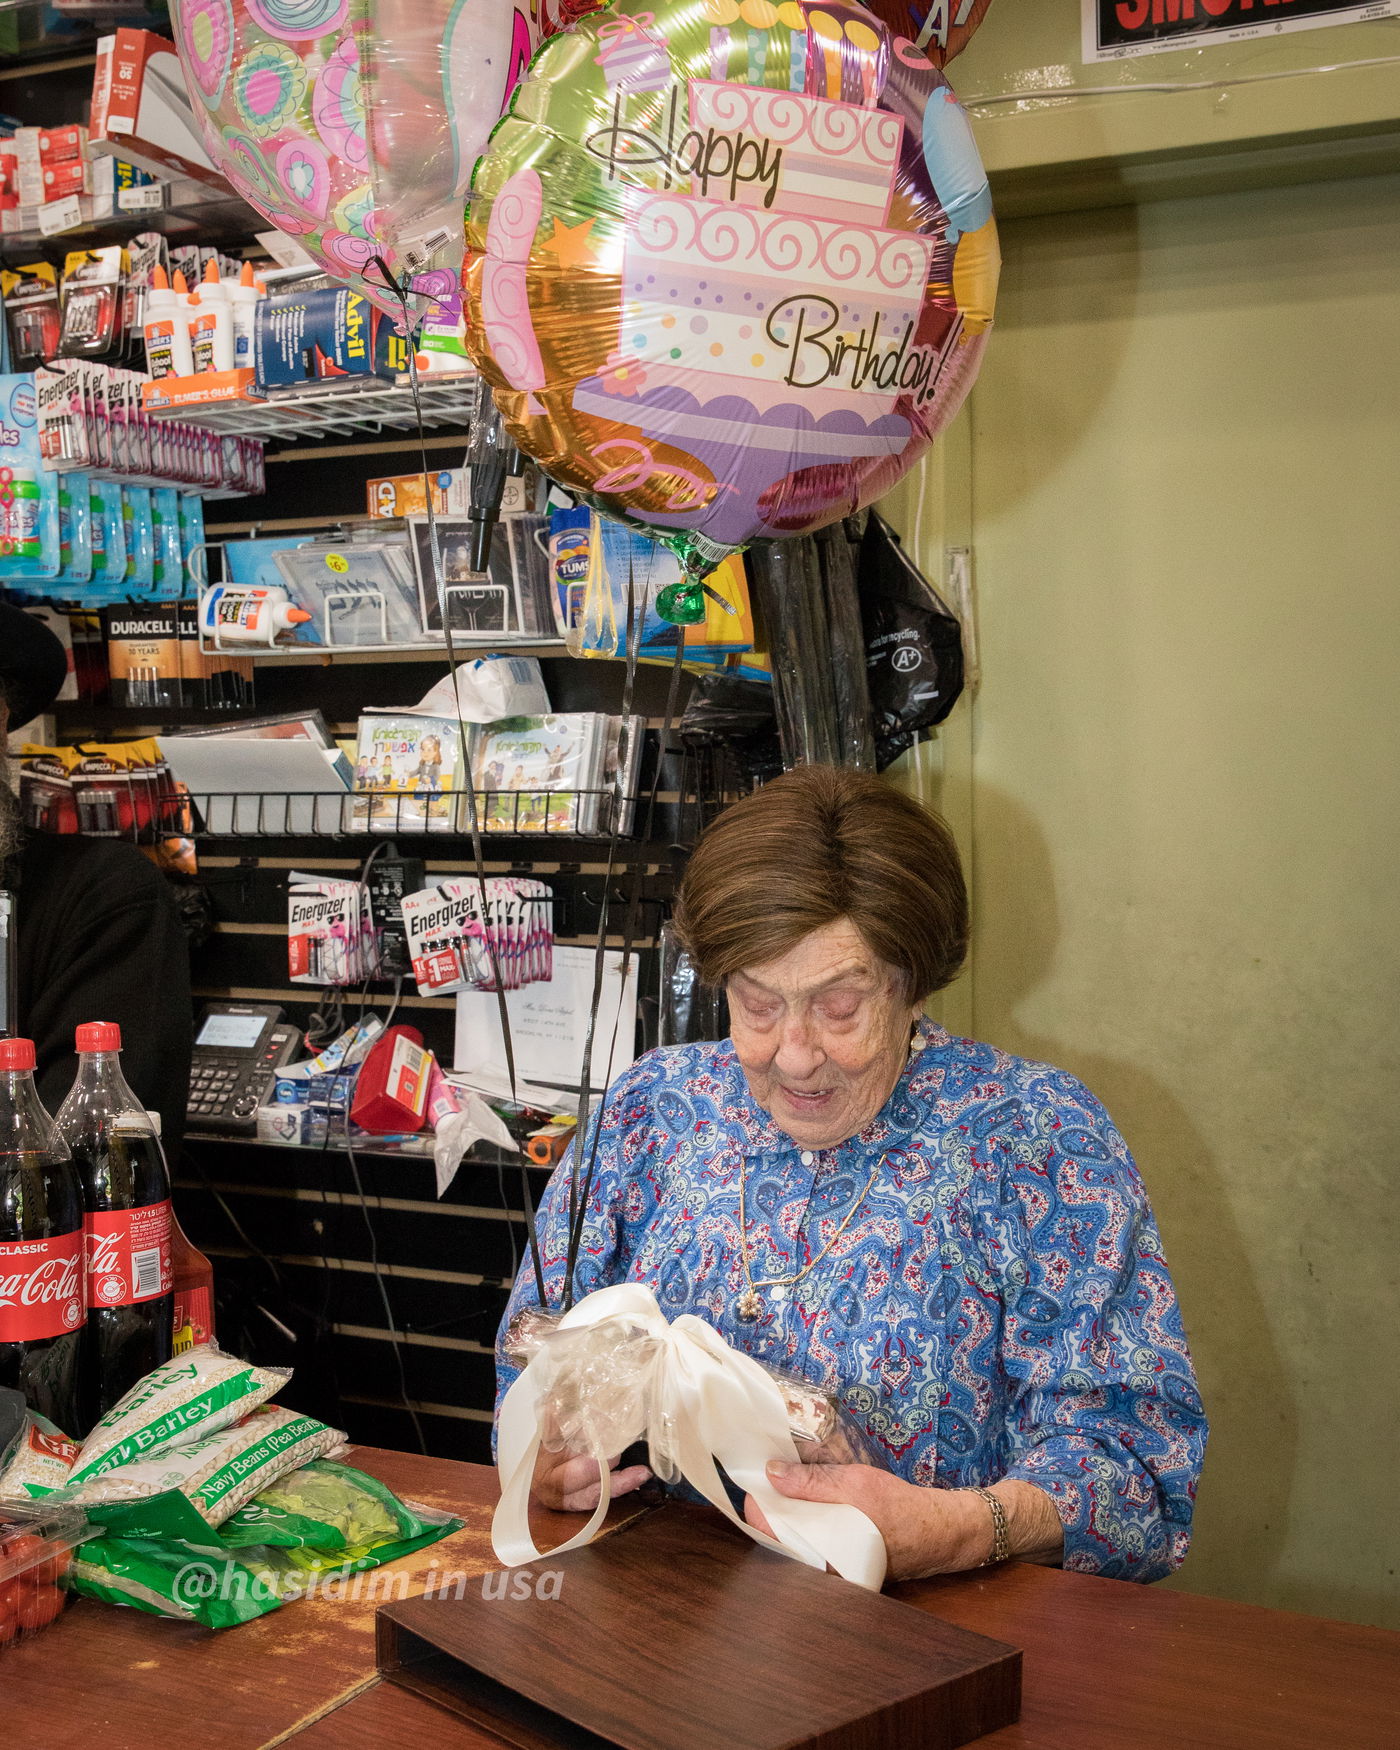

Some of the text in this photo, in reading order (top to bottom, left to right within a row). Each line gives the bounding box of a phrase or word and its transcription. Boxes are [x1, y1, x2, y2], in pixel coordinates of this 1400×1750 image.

[586, 83, 783, 208] Happy
[346, 290, 365, 359] Advil
[765, 294, 965, 406] Birthday!
[39, 369, 80, 408] Energizer
[560, 561, 589, 574] TUMS
[111, 620, 174, 635] DURACELL
[138, 647, 160, 655] YEARS
[291, 898, 345, 923] Energizer
[411, 894, 475, 937] Energizer
[0, 1243, 48, 1255] CLASSIC
[100, 1363, 199, 1428] Barley
[131, 1396, 213, 1448] Barley
[200, 1418, 325, 1500] Navy Beans (Pea Beans)
